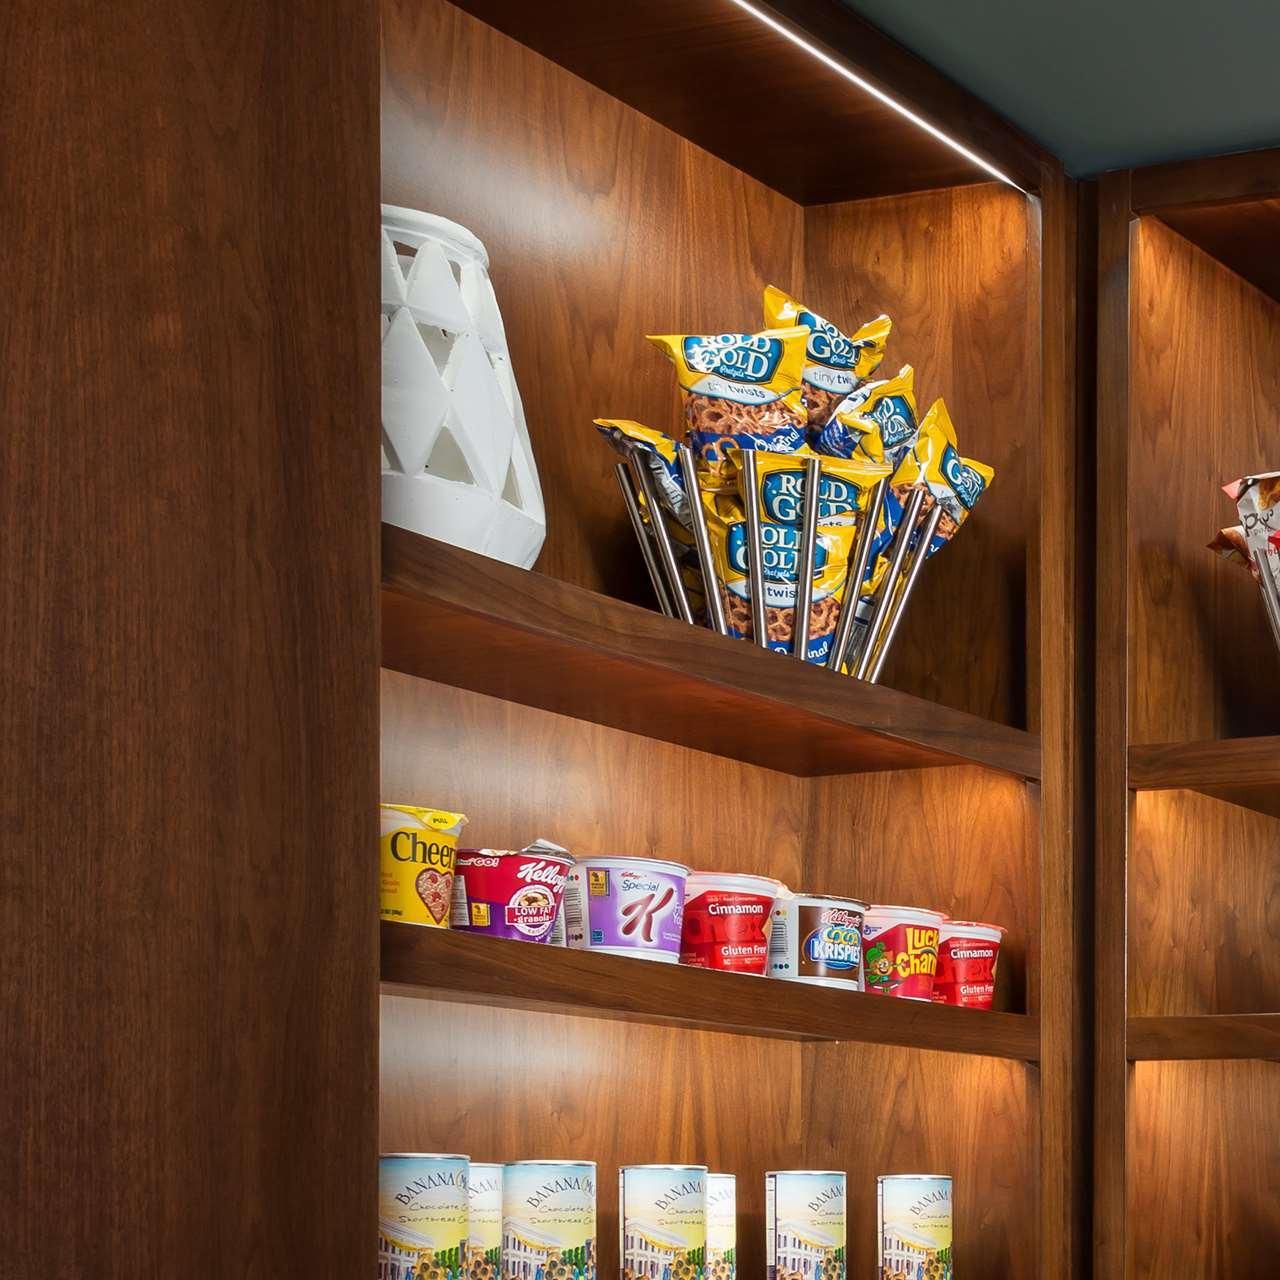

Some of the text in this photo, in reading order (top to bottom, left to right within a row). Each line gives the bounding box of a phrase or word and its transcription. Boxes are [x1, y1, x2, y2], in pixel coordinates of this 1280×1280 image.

[622, 879, 660, 892] Special
[515, 907, 537, 916] LOW
[622, 887, 675, 943] K
[708, 903, 764, 916] Cinnamon
[721, 945, 752, 956] Gluten
[950, 949, 994, 960] Cinnamon
[960, 985, 984, 994] Gluten
[395, 1171, 456, 1206] BANANA
[526, 1176, 581, 1209] BANANA
